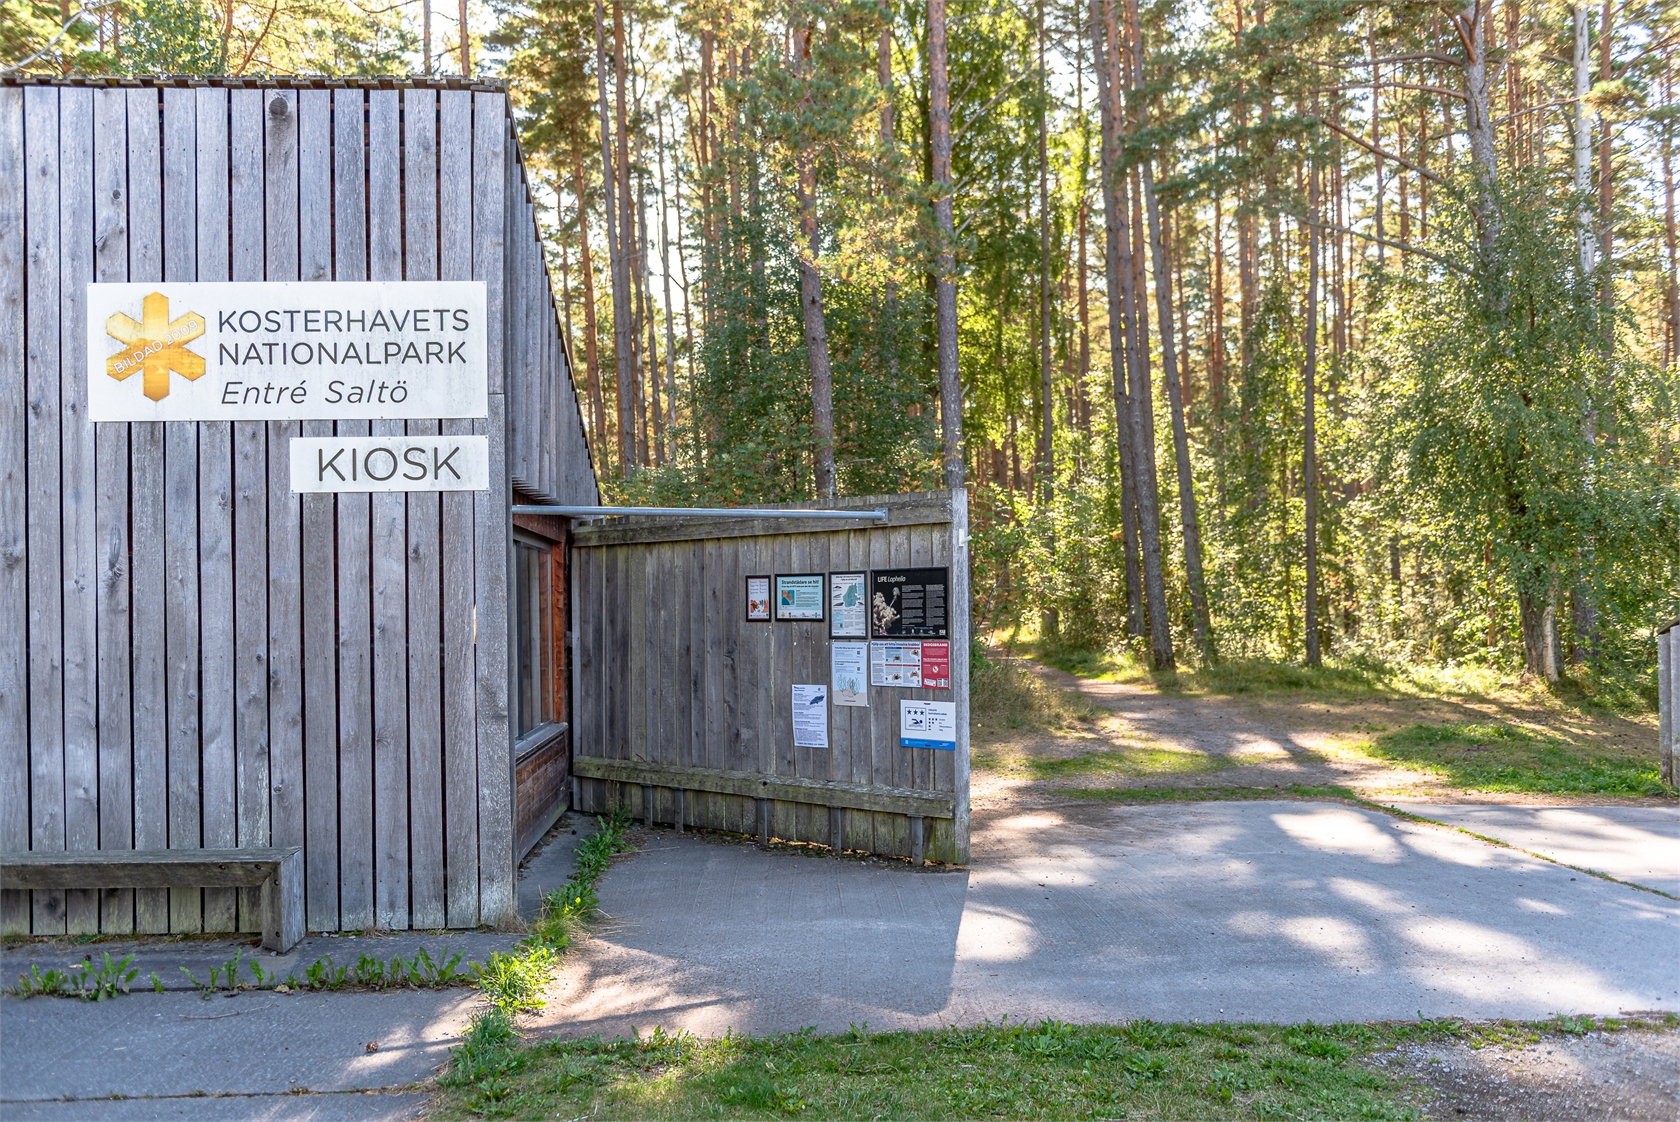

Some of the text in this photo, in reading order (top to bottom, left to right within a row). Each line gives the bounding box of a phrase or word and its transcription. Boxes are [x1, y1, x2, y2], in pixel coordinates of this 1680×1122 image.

[218, 309, 469, 333] KOSTERHAVETS
[113, 320, 198, 374] BILDAD 2009
[219, 341, 467, 365] NATIONALPARK
[221, 379, 408, 405] Entré Saltö
[318, 446, 461, 482] KIOSK
